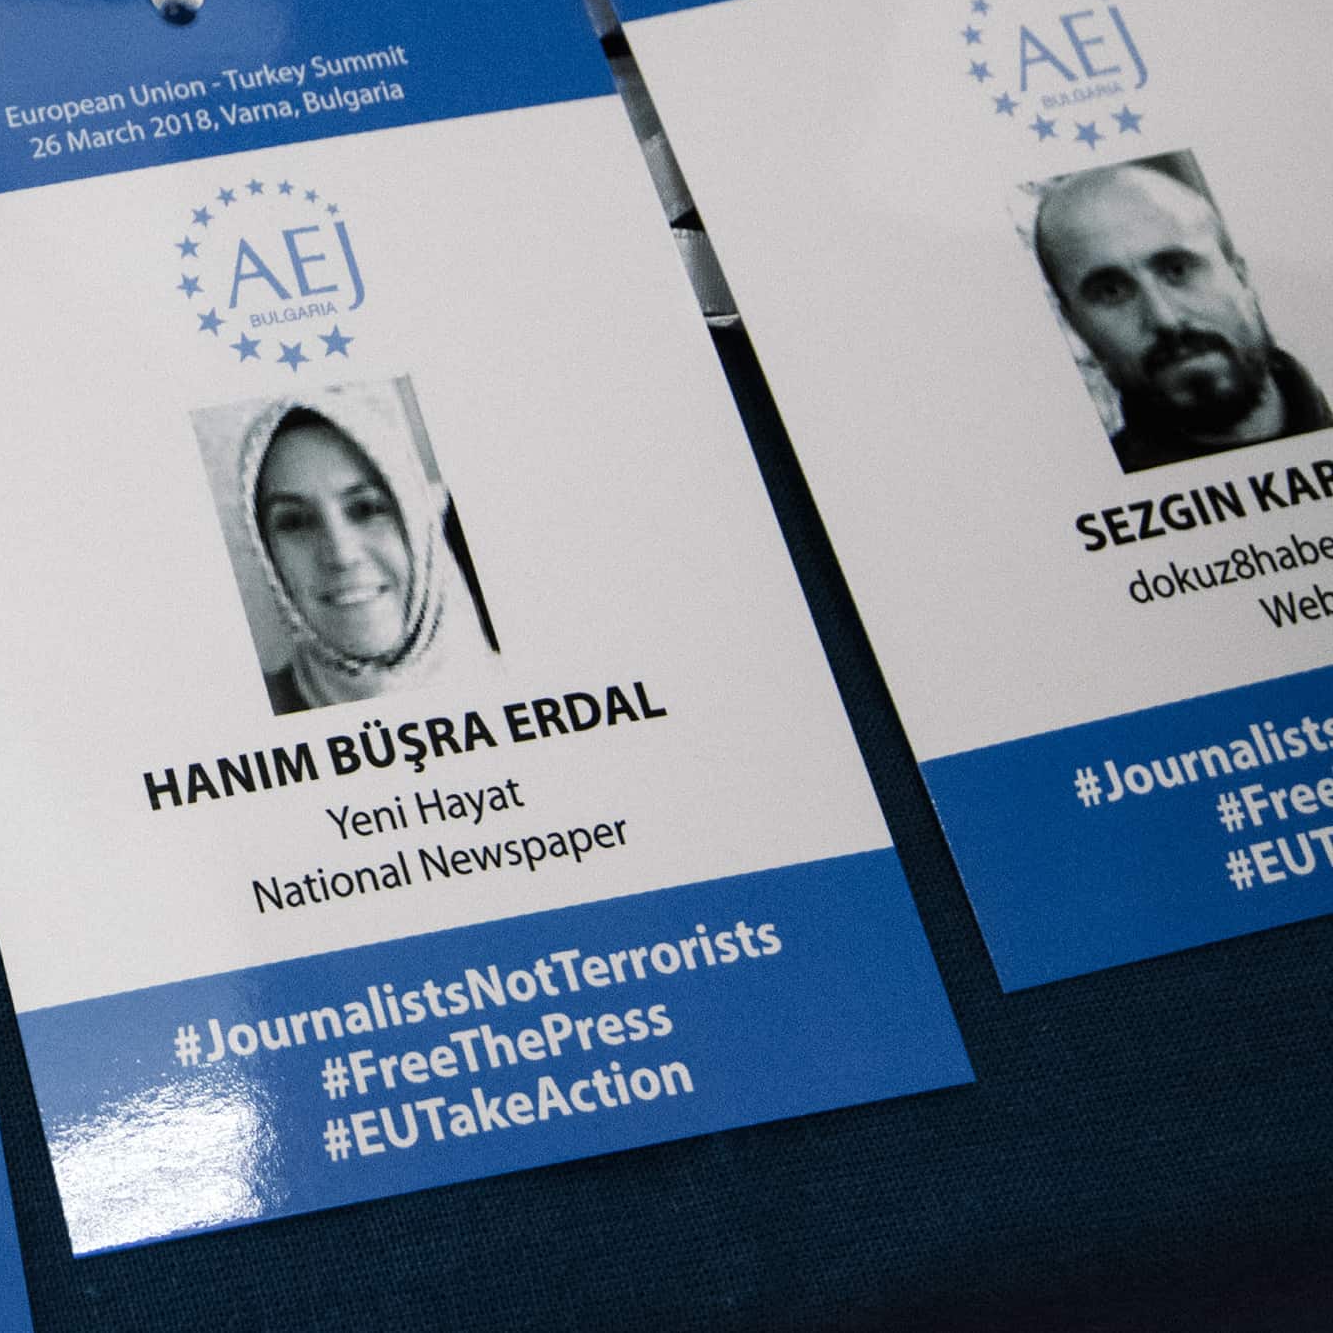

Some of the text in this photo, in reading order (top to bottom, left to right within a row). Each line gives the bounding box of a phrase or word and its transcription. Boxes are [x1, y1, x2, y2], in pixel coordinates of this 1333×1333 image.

[4, 92, 127, 126] European
[127, 79, 208, 107] Union
[225, 62, 306, 90] Turkey
[309, 44, 409, 78] Summit
[1017, 3, 1149, 91] AEJ
[28, 79, 404, 157] 26 March 2018, Varna, Bulgaria
[1041, 80, 1122, 110] BULGARIA
[228, 219, 366, 311] AEJ
[249, 301, 338, 328] BULGARIA
[1075, 459, 1333, 552] SEZGIN KAR
[1128, 533, 1333, 603] dokuz8habe
[1259, 583, 1333, 628] Web
[143, 681, 667, 810] HANIM BÜŞRA ERDAL
[1074, 716, 1333, 807] #Journalists
[326, 779, 524, 839] Yeni Hayat
[1217, 779, 1333, 833] #Free
[252, 819, 626, 913] National Newspaper
[1226, 832, 1333, 890] #EUT
[174, 921, 782, 1065] #JournalistsNotTerrorists
[322, 1003, 673, 1099] #FreeThePress
[323, 1058, 694, 1162] #EUTakeAction
